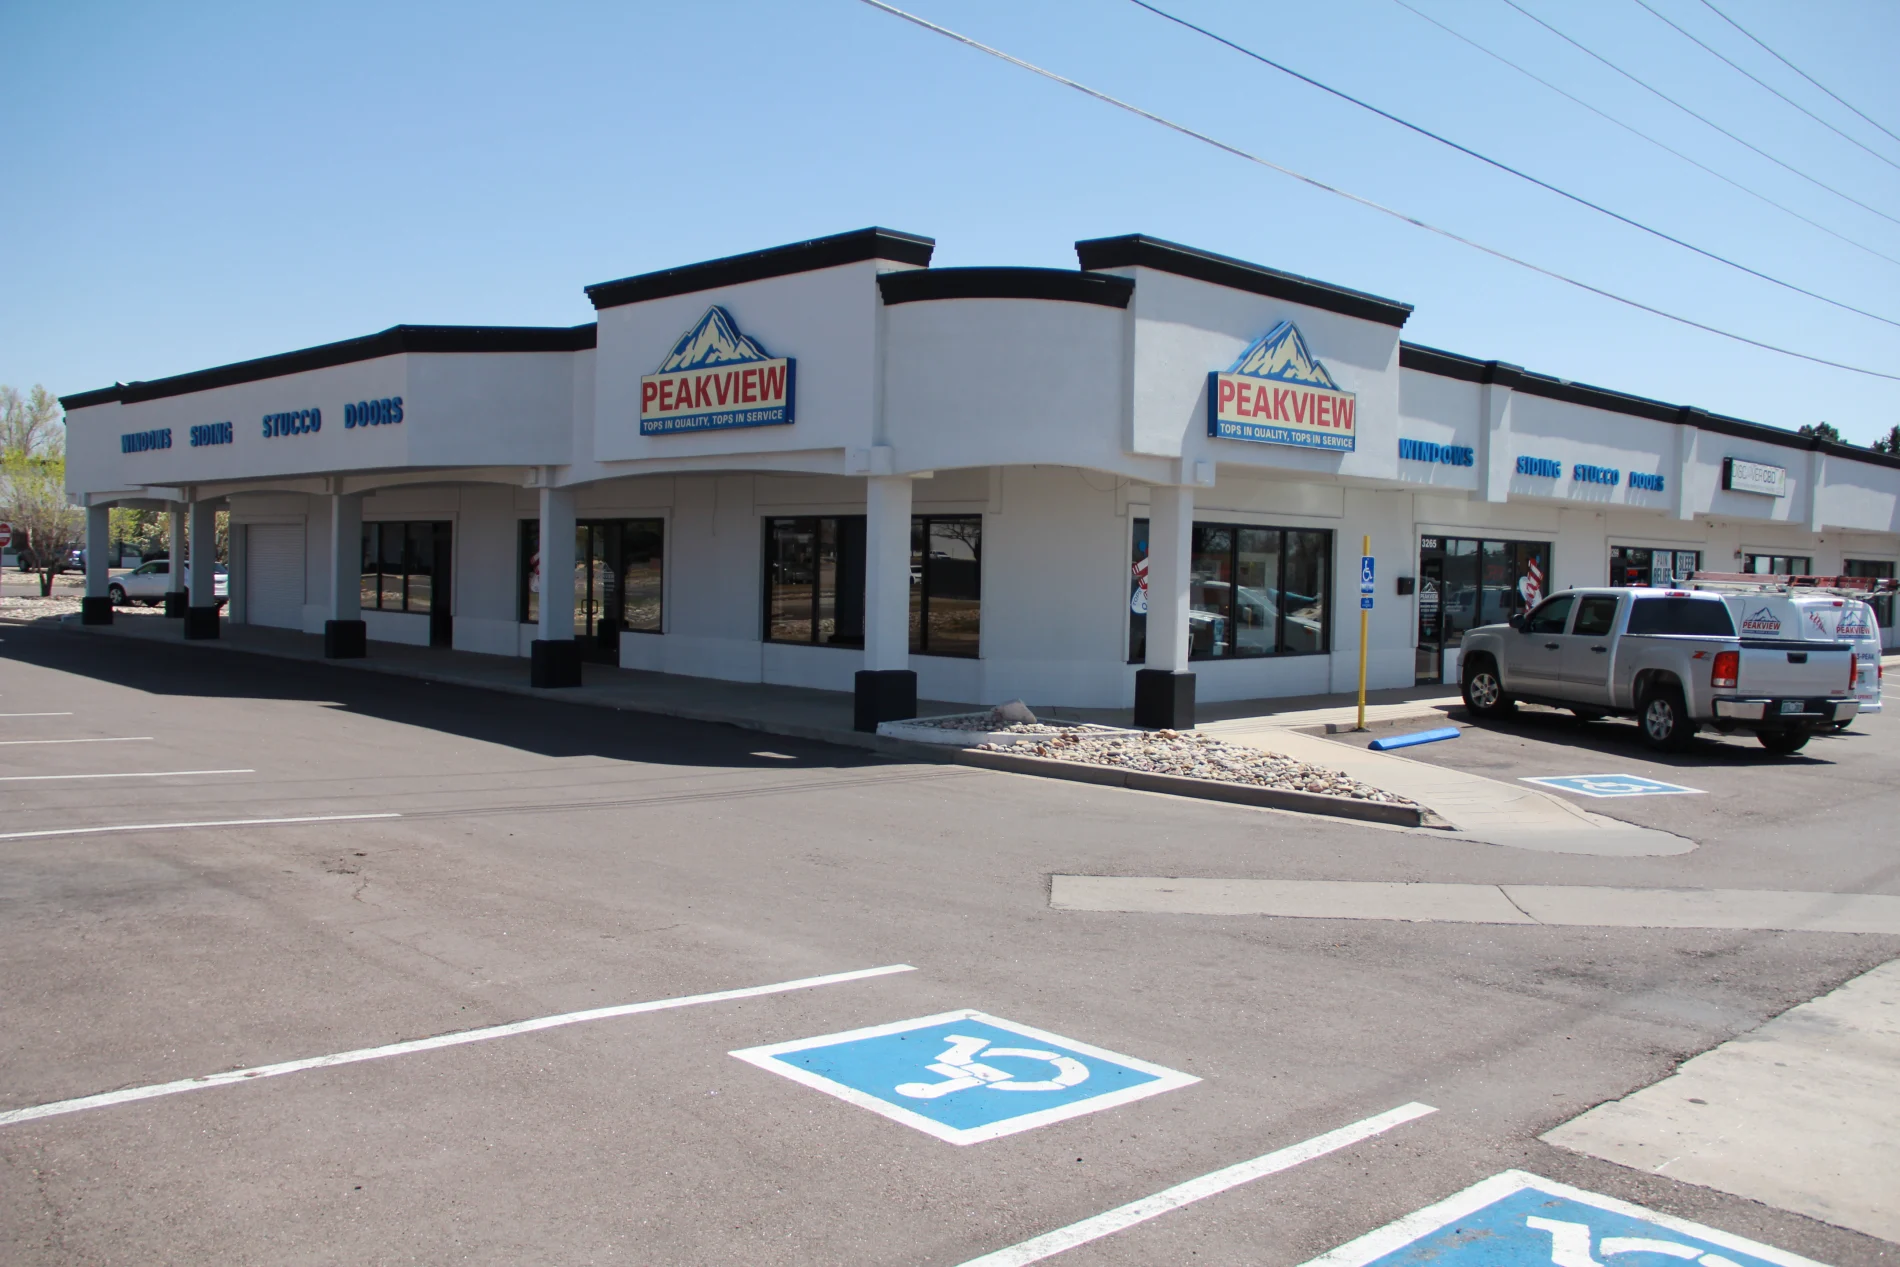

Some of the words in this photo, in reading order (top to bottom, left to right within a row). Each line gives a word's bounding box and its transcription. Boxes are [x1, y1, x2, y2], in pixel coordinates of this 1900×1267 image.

[642, 365, 785, 413] PEAKVIEW
[1219, 379, 1354, 429] PEAKVIEW
[121, 428, 172, 454] WINDOWS
[190, 421, 233, 447] SIDING
[262, 407, 322, 439] STUCCO
[344, 396, 403, 429] DOORS
[643, 419, 662, 431] TOPS
[664, 418, 673, 429] IN
[675, 415, 710, 428] QUALITY,
[712, 413, 733, 425] TOPS
[735, 412, 745, 423] IN
[746, 409, 783, 422] SERVICE
[1220, 423, 1241, 435] TOPS
[1243, 425, 1252, 436] IN
[1254, 427, 1290, 441] QUALITY,
[1292, 431, 1311, 443] TOPS
[1312, 434, 1321, 444] IN
[1322, 435, 1352, 448] SERVICE
[1398, 438, 1474, 467] WINDOWS
[1516, 455, 1562, 479] SIDING
[1574, 463, 1620, 486] STUCCO
[1629, 471, 1665, 492] DOORS
[1421, 538, 1437, 549] 3265
[1656, 554, 1668, 567] PAIN
[1678, 555, 1694, 572] SLEEP
[1653, 567, 1671, 585] RELIEF
[1132, 588, 1143, 606] TOPS
[1742, 621, 1781, 630] PEAKVIEW
[1836, 626, 1870, 635] PEAKVIEW
